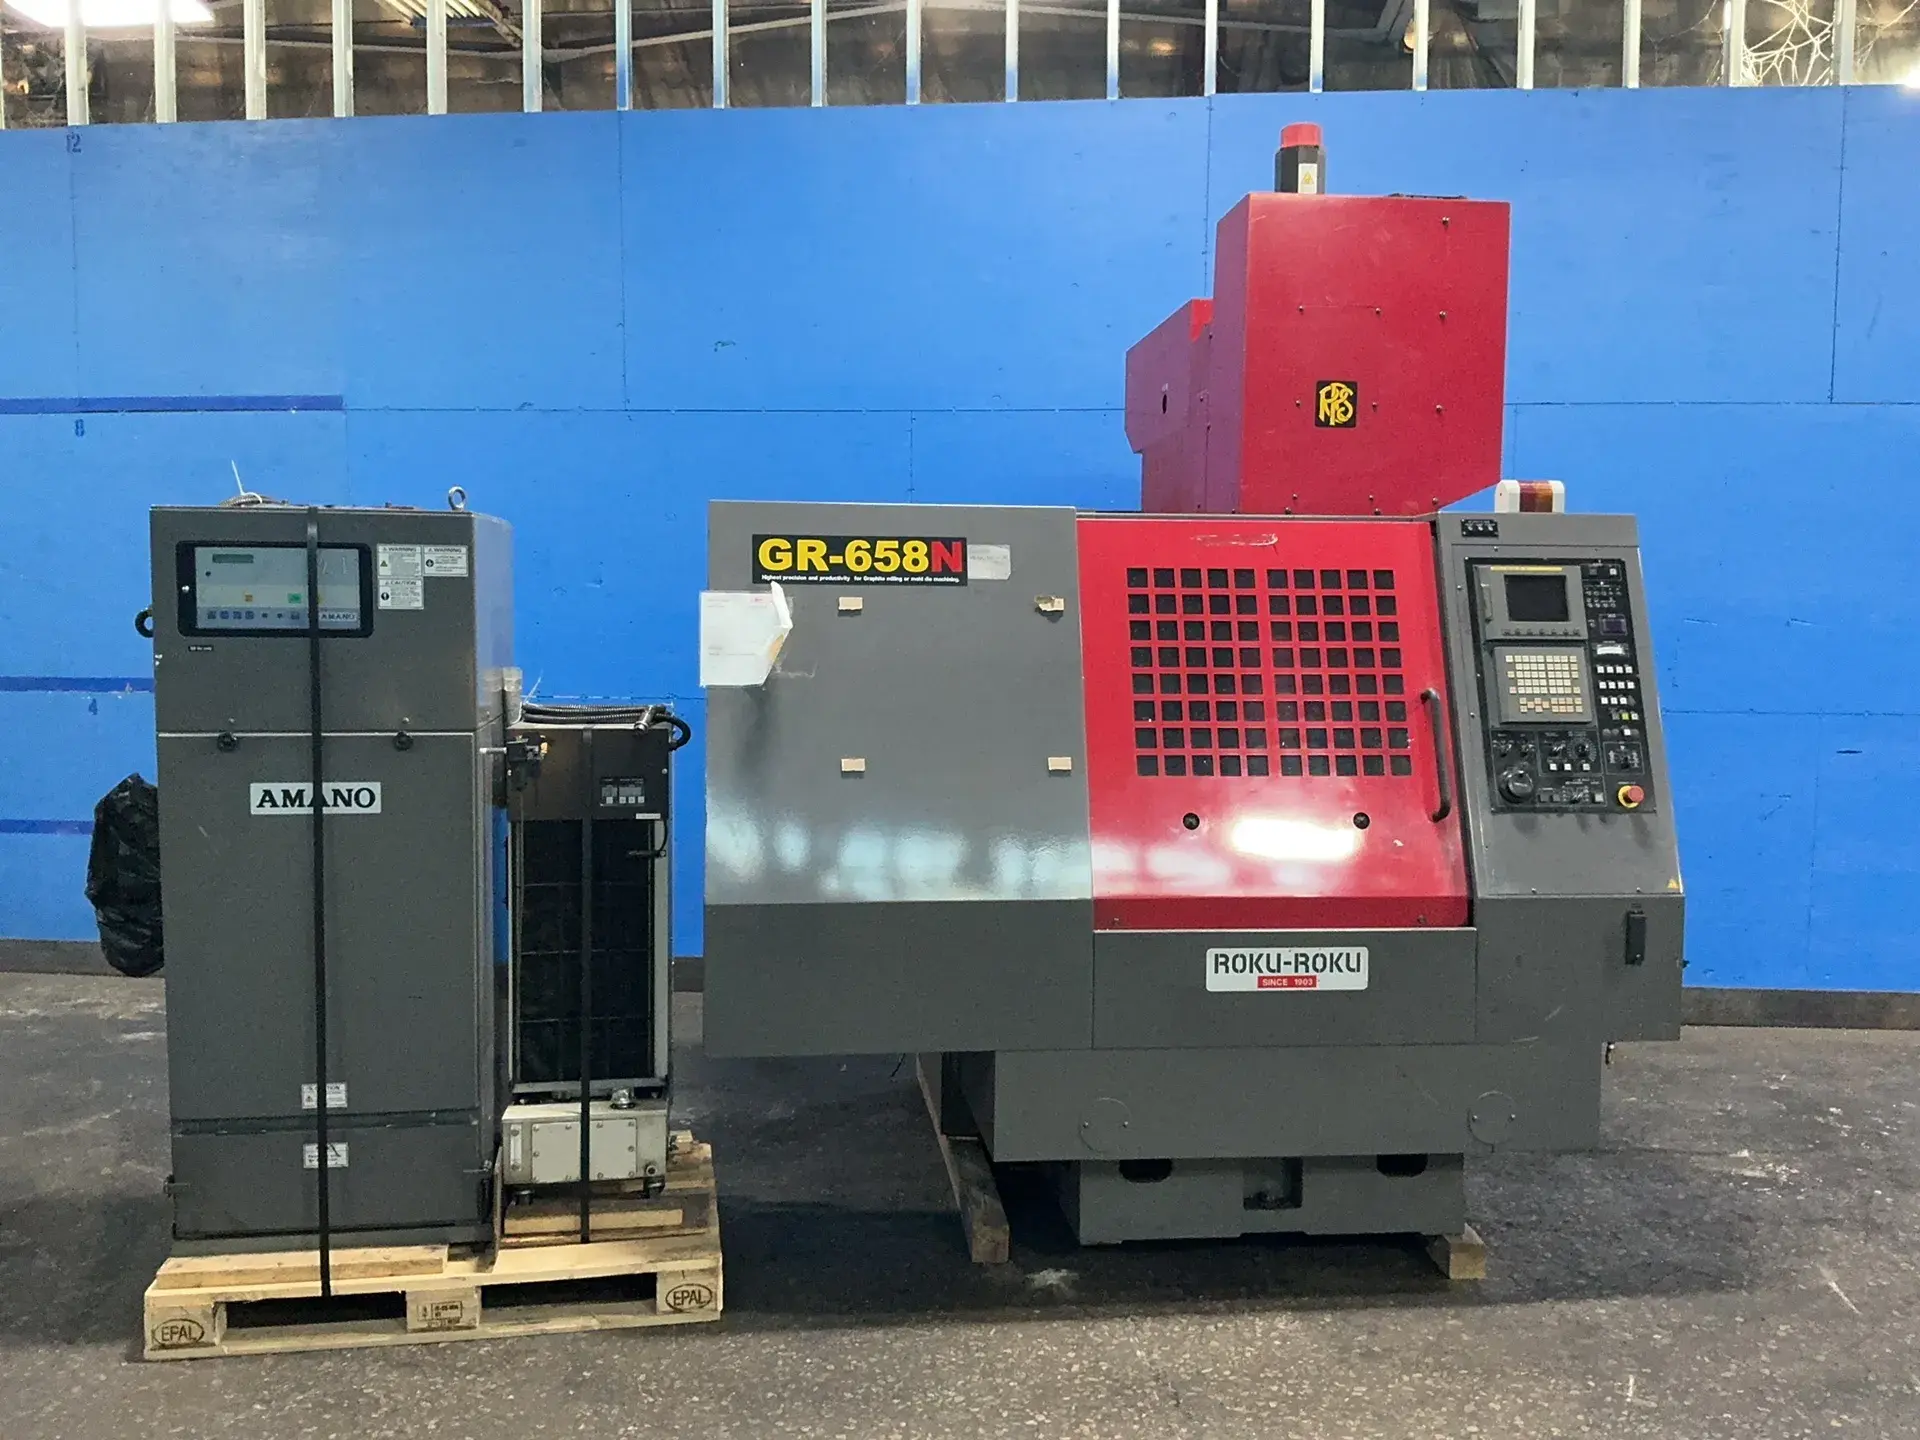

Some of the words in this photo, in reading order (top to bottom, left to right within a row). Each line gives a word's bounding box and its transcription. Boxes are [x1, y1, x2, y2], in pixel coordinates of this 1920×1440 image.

[758, 538, 963, 573] GR-658N
[761, 574, 782, 582] Highest
[1213, 952, 1361, 974] ROKU-ROKU
[1262, 978, 1288, 987] SINCE
[1294, 978, 1313, 986] 1903
[673, 1289, 706, 1306] EPAL
[161, 1325, 197, 1342] EPAL
